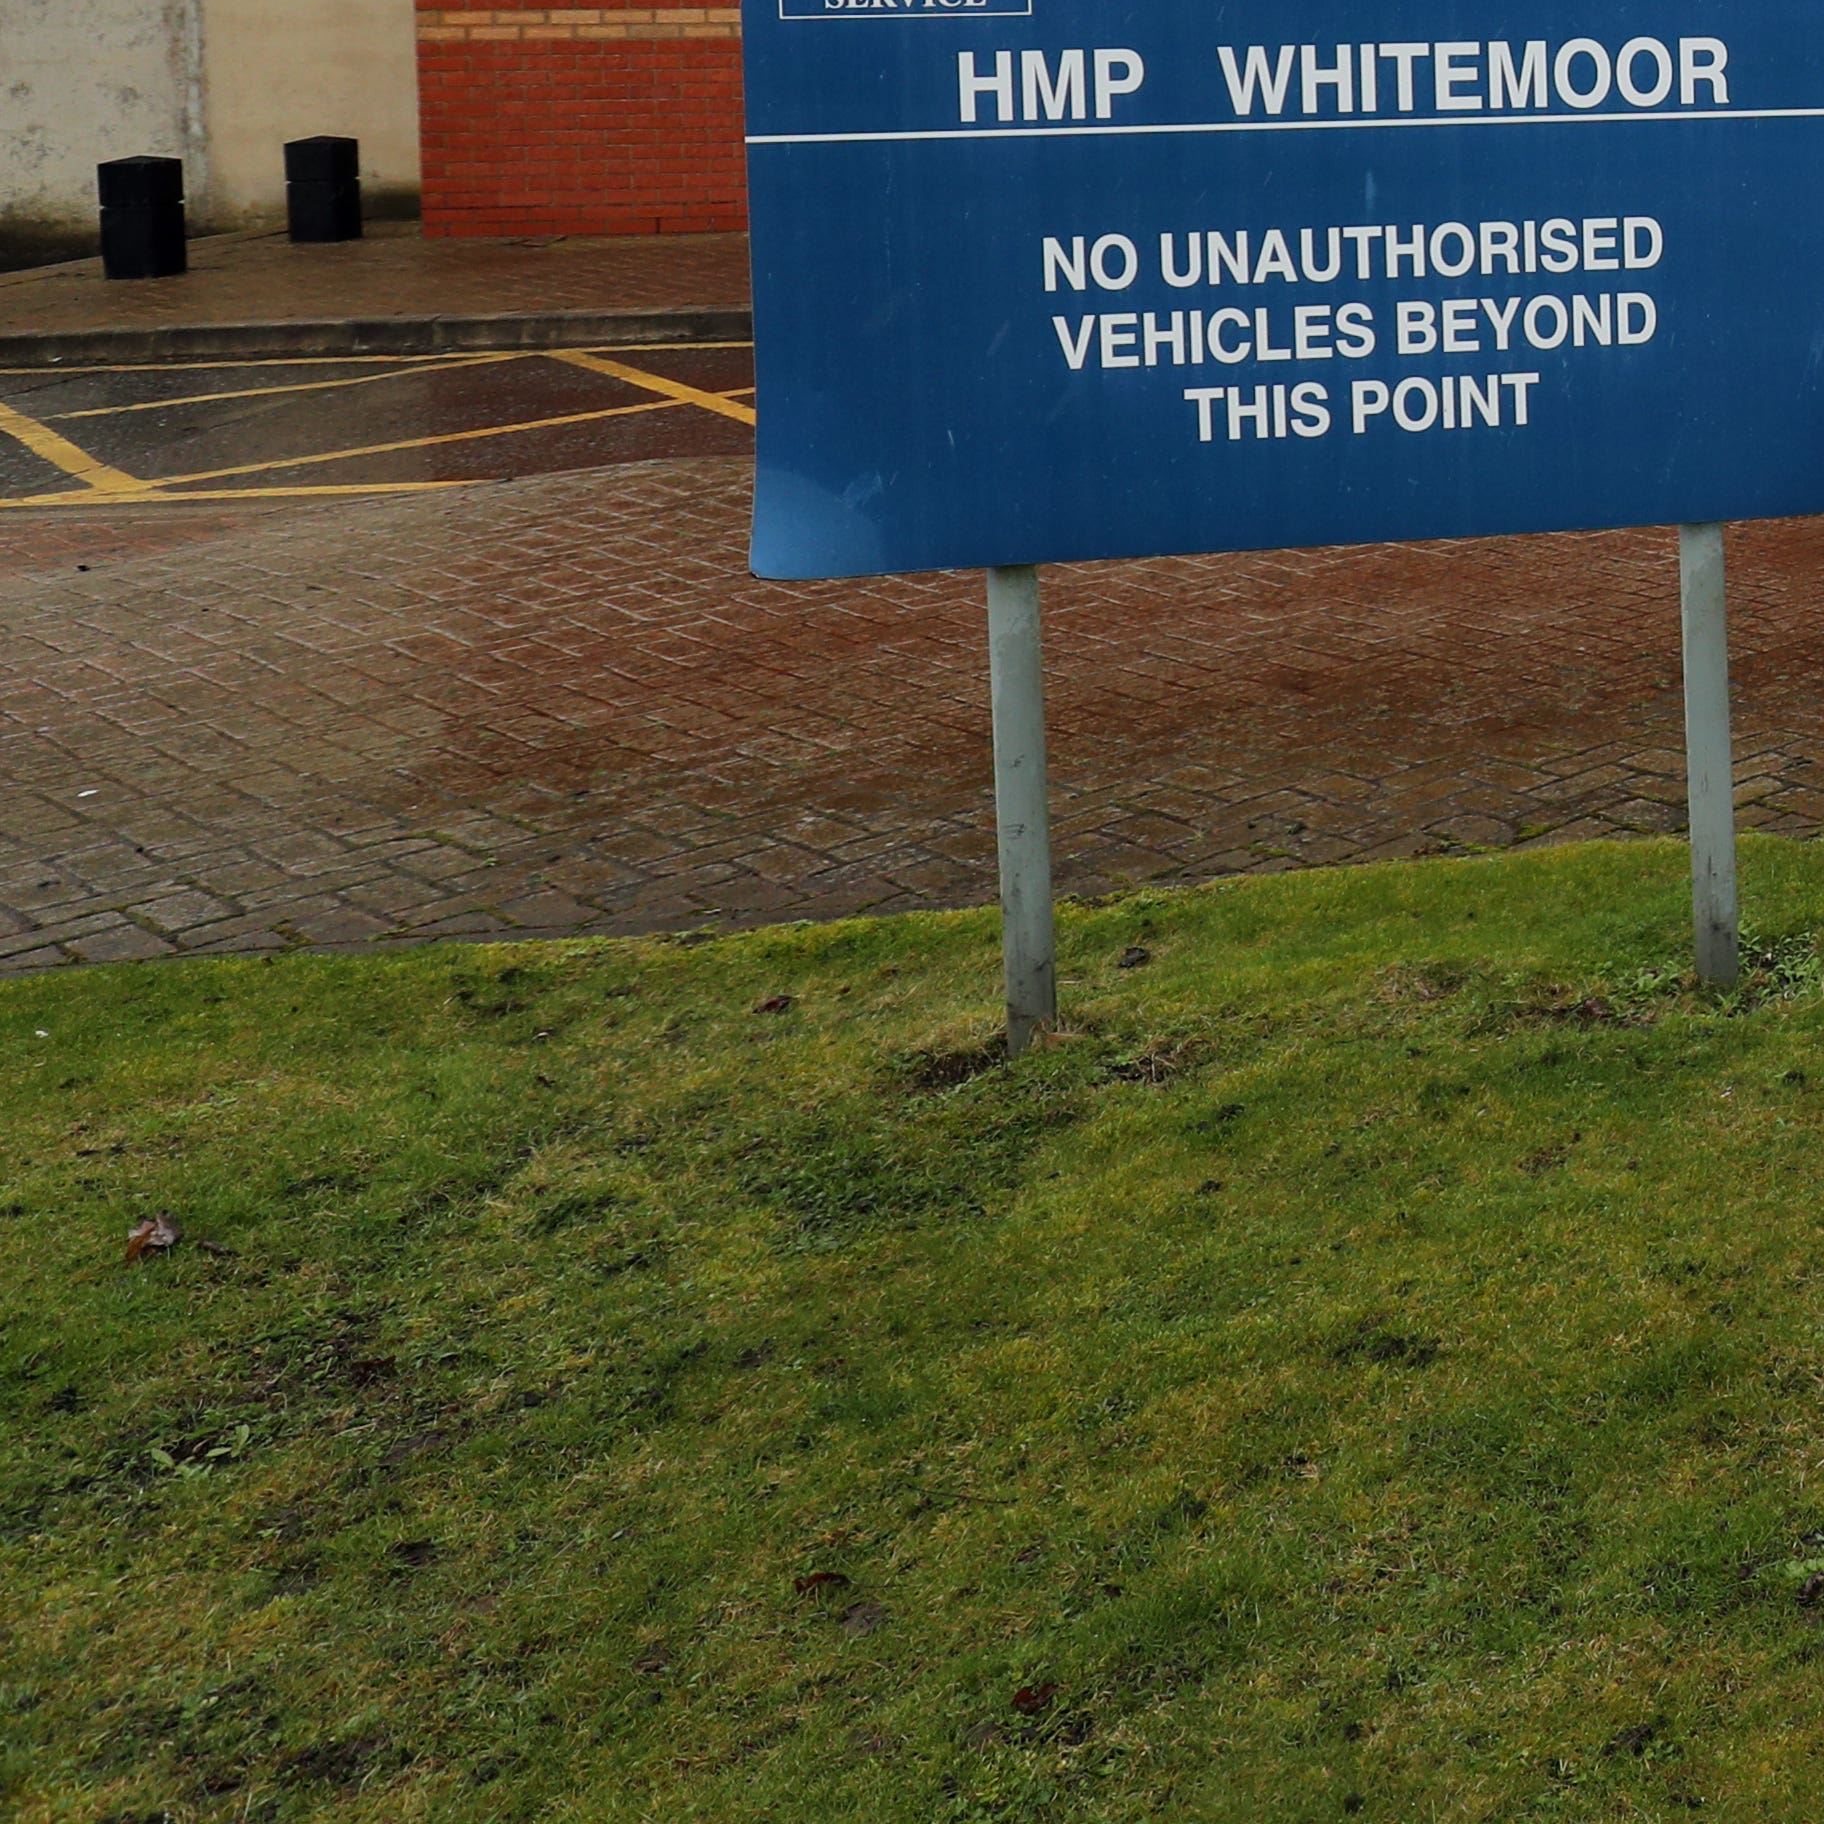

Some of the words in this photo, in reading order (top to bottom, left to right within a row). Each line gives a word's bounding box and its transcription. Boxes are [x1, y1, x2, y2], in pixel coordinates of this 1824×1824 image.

[958, 48, 1145, 123] HMP
[1217, 37, 1730, 116] WHITEMOOR
[1043, 233, 1138, 292] NO
[1160, 216, 1663, 289] UNAUTHORISED
[1052, 300, 1376, 370] VEHICLES
[1396, 292, 1657, 356] BEYOND
[1183, 380, 1331, 442] THIS
[1351, 372, 1540, 434] POINT
